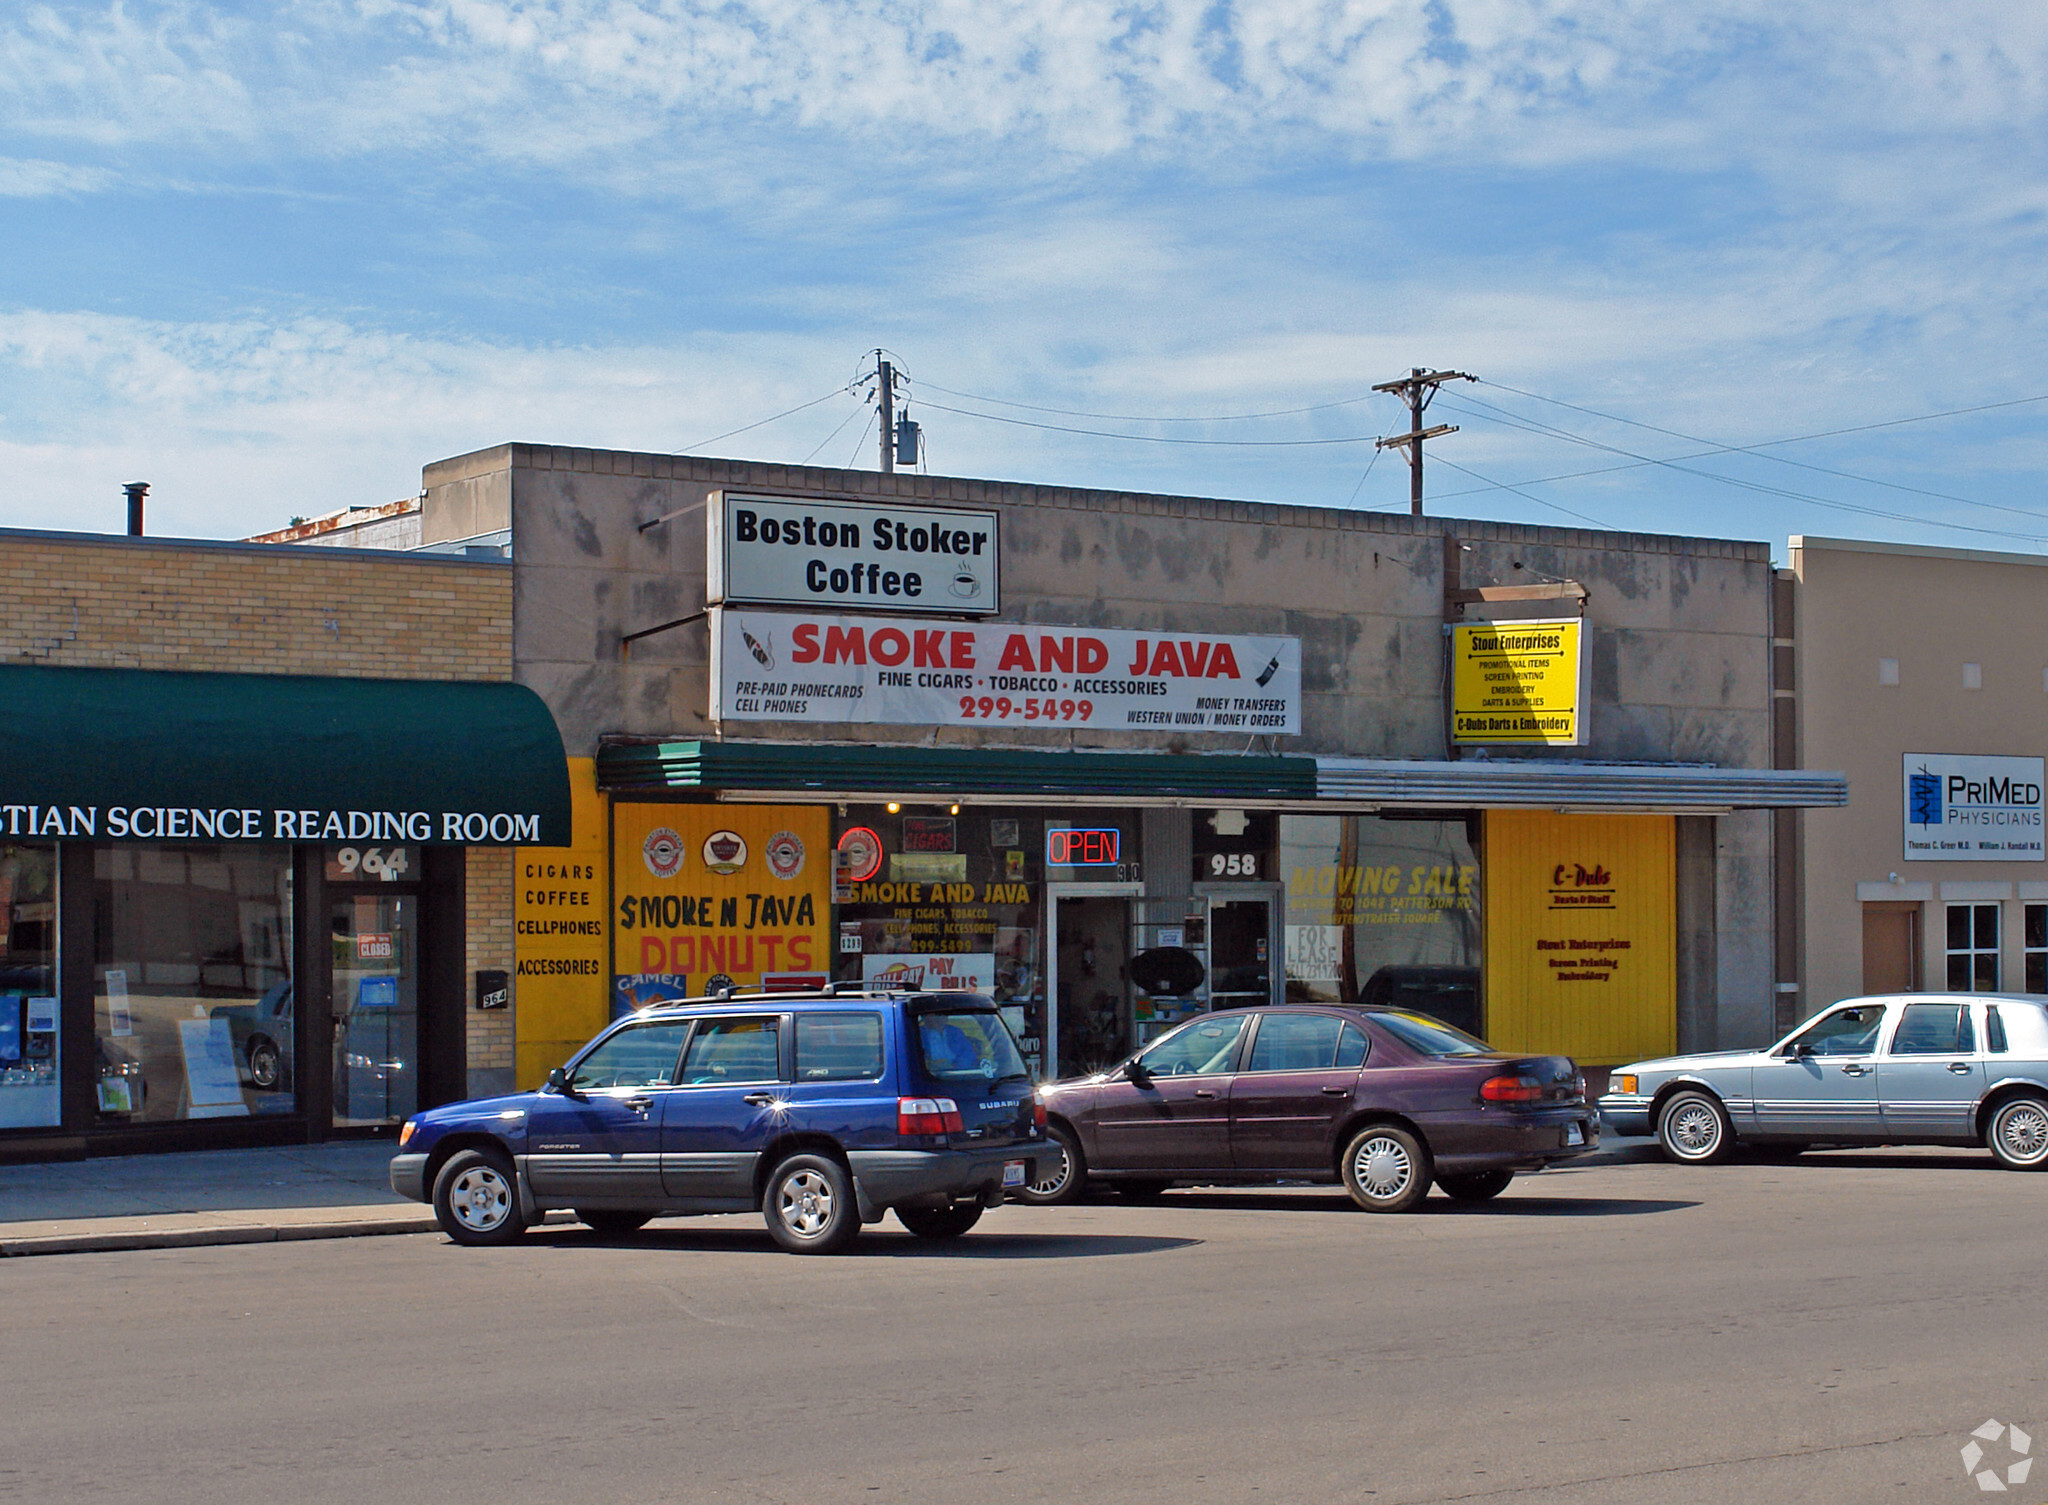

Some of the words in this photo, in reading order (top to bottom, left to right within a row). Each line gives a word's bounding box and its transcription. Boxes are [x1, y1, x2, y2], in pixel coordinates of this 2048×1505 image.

[737, 510, 859, 548] Boston
[873, 518, 987, 555] Stoker
[806, 559, 922, 597] Coffee
[792, 623, 976, 669] SMOKE
[998, 633, 1109, 674] AND
[1129, 639, 1241, 679] JAVA
[1472, 636, 1498, 651] Stout
[1501, 634, 1560, 652] Enterprises
[1479, 660, 1526, 669] PROMOTIONAL
[1528, 659, 1549, 668] ITEMS
[878, 672, 912, 687] FINE
[918, 673, 973, 690] CIGARS
[989, 676, 1057, 692] TOBACCO
[1074, 679, 1167, 695] ACCESSORIES
[1484, 672, 1510, 681] SCREEN
[1512, 672, 1544, 680] PRINTING
[736, 681, 787, 696] PRE-PAID
[791, 683, 863, 699] PHONECARDS
[1491, 686, 1535, 694] EMBROIDERY
[735, 698, 759, 712] CELL
[764, 699, 807, 714] PHONES
[959, 696, 1093, 721] 299-5499
[1196, 697, 1230, 710] MONEY
[1233, 698, 1285, 712] TRANSFERS
[1482, 698, 1503, 707] DARTS
[1505, 698, 1510, 706] &
[1512, 698, 1544, 706] SUPPLIES
[1127, 710, 1172, 724] WESTERN
[1175, 711, 1204, 725] UNION
[1214, 713, 1246, 726] MONEY
[1250, 714, 1285, 727] ORDERS
[1458, 718, 1487, 731] C-Dubs
[1489, 718, 1510, 730] Darts
[1513, 719, 1517, 729] &
[1520, 717, 1569, 731] Embroidery
[1948, 775, 2040, 805] PRIMED
[0, 805, 97, 836] TIAN
[106, 806, 262, 838] SCIENCE
[273, 809, 431, 841] READING
[442, 812, 540, 842] ROOM
[1948, 809, 2041, 826] PHYSICIANS
[1050, 832, 1117, 863] OPEN
[1908, 841, 1930, 849] Thomas
[337, 847, 408, 874] 964
[1211, 854, 1255, 875] 958
[526, 864, 593, 880] CIGARS
[1290, 865, 1400, 896] MOVING
[1408, 866, 1476, 895] SALE
[526, 890, 590, 906] COFFEE
[850, 882, 921, 904] SMOKE
[930, 883, 975, 903] AND
[983, 884, 1030, 904] JAVA
[620, 894, 713, 930] SMOKE
[720, 896, 737, 928] N
[743, 893, 815, 930] JAVA
[1390, 897, 1453, 909] PATTERSON
[894, 908, 912, 919] FINE
[951, 908, 988, 919] TOBACCO
[518, 920, 602, 935] CELLPHONES
[944, 923, 997, 934] ACCESSORIES
[1299, 926, 1328, 946] FOR
[361, 943, 391, 956] CLOSED
[641, 935, 812, 974] DONUTS
[911, 940, 972, 952] 299-5499
[1288, 945, 1337, 963] LEASE
[517, 959, 599, 975] ACCESSORIES
[929, 958, 954, 974] PAY
[618, 974, 684, 991] CAMEL
[484, 991, 506, 1006] 964
[979, 1100, 1020, 1109] SUBARU
